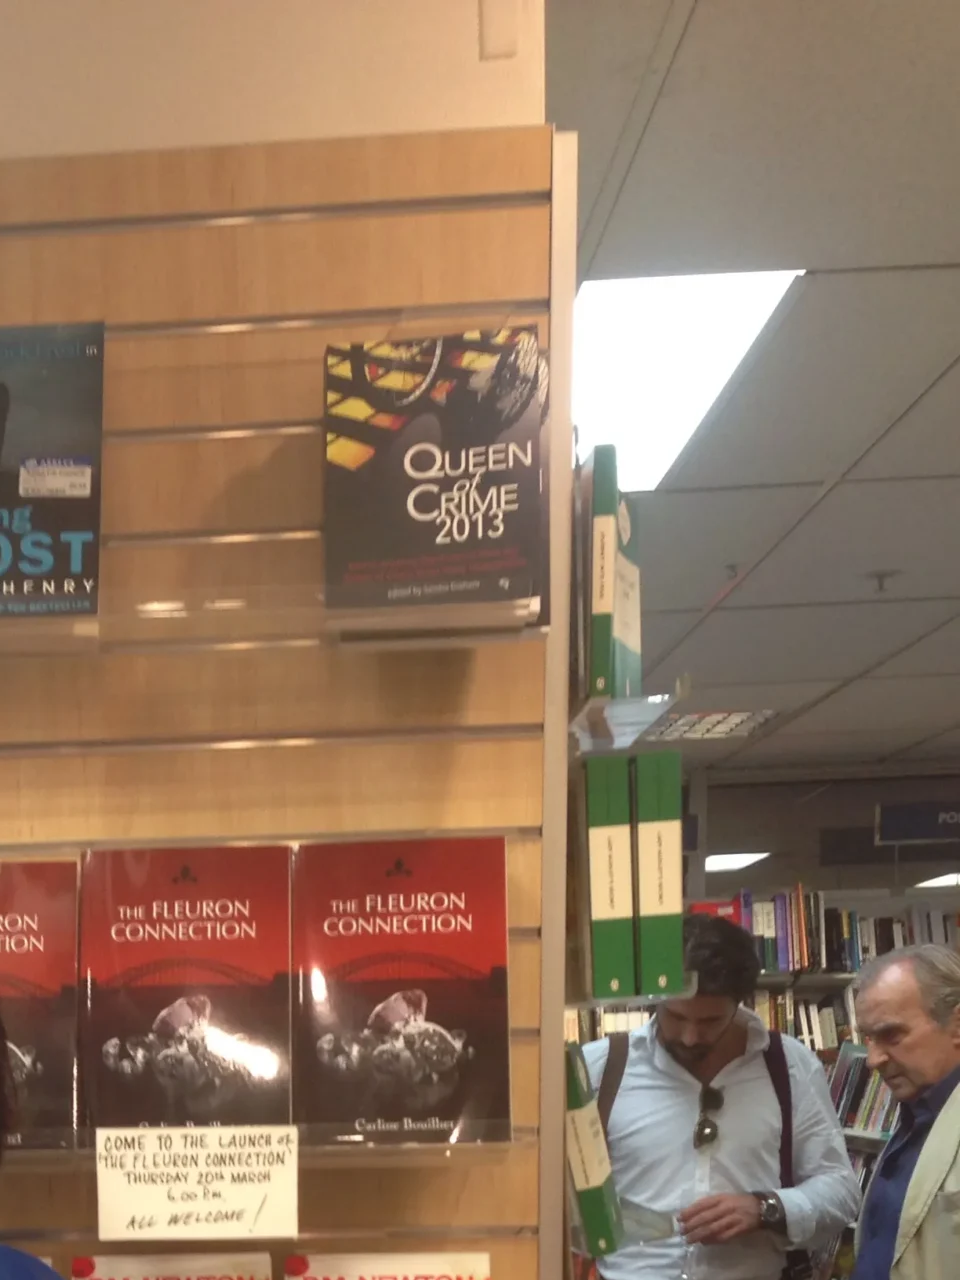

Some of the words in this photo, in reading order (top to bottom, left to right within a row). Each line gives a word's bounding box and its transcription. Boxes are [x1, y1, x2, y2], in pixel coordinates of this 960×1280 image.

[403, 440, 533, 479] QUEEN
[453, 468, 485, 501] of
[407, 483, 520, 522] CRIME
[435, 511, 505, 544] 2013
[2, 578, 95, 596] HENRY
[938, 811, 960, 826] PO
[118, 905, 145, 921] THE
[152, 899, 250, 920] FLEURON
[330, 899, 359, 914] THE
[366, 892, 466, 913] FLEURON
[111, 920, 257, 943] CONNECTION
[323, 913, 473, 937] CONNECTION
[104, 1134, 146, 1151] COME
[157, 1134, 173, 1150] TO
[181, 1133, 206, 1149] THE
[218, 1133, 272, 1148] LAUNCH
[132, 1152, 199, 1170] FLEURON
[124, 1171, 189, 1185] THURSDAY
[230, 1170, 271, 1184] MARCH
[126, 1214, 158, 1230] ALL
